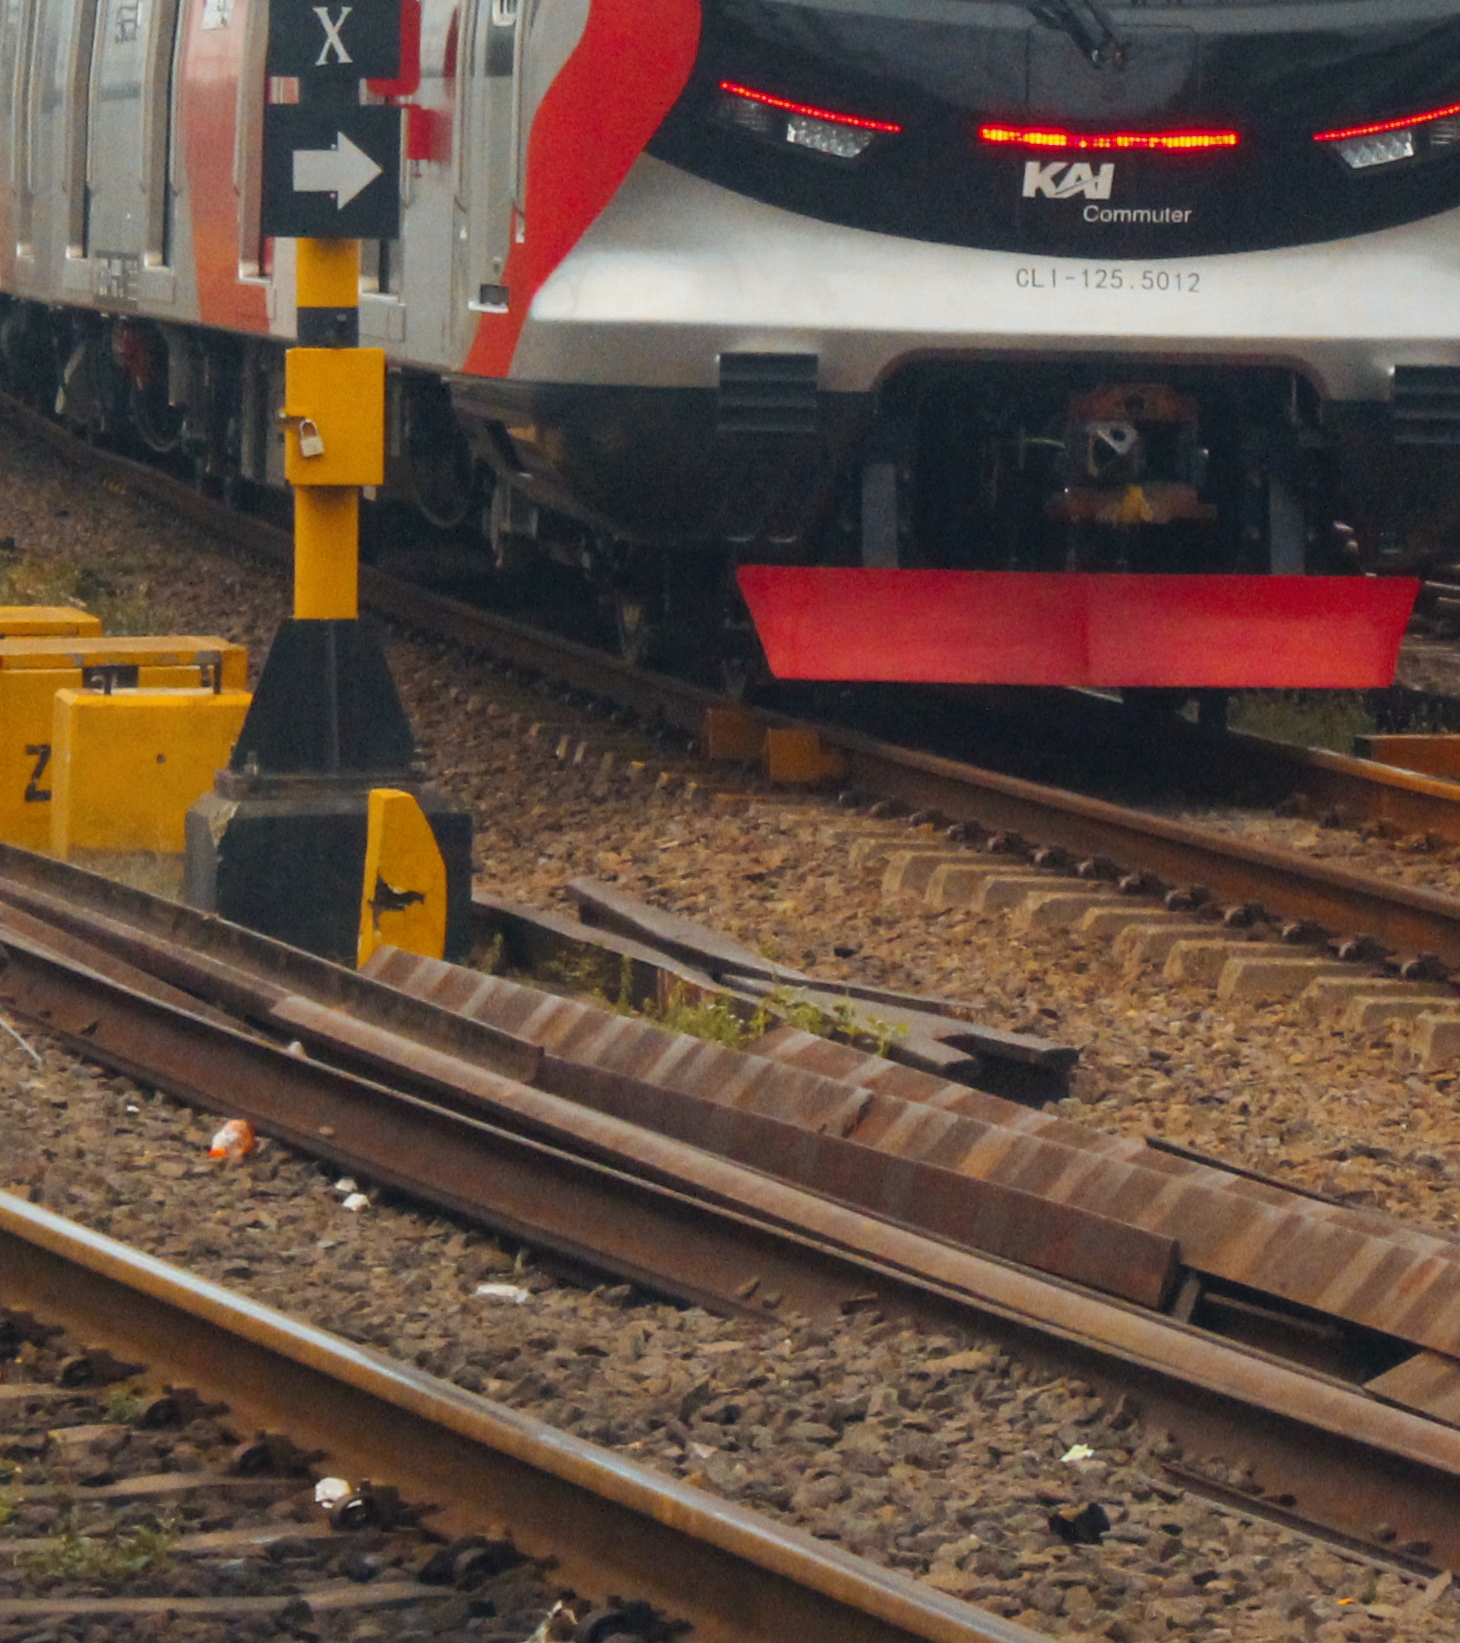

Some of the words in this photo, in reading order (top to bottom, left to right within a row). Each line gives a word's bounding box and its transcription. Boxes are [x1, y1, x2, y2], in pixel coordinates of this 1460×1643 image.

[312, 7, 354, 66] X
[1022, 161, 1115, 200] KAI
[1083, 205, 1192, 223] Commuter
[1015, 268, 1201, 293] CLI-125.5012
